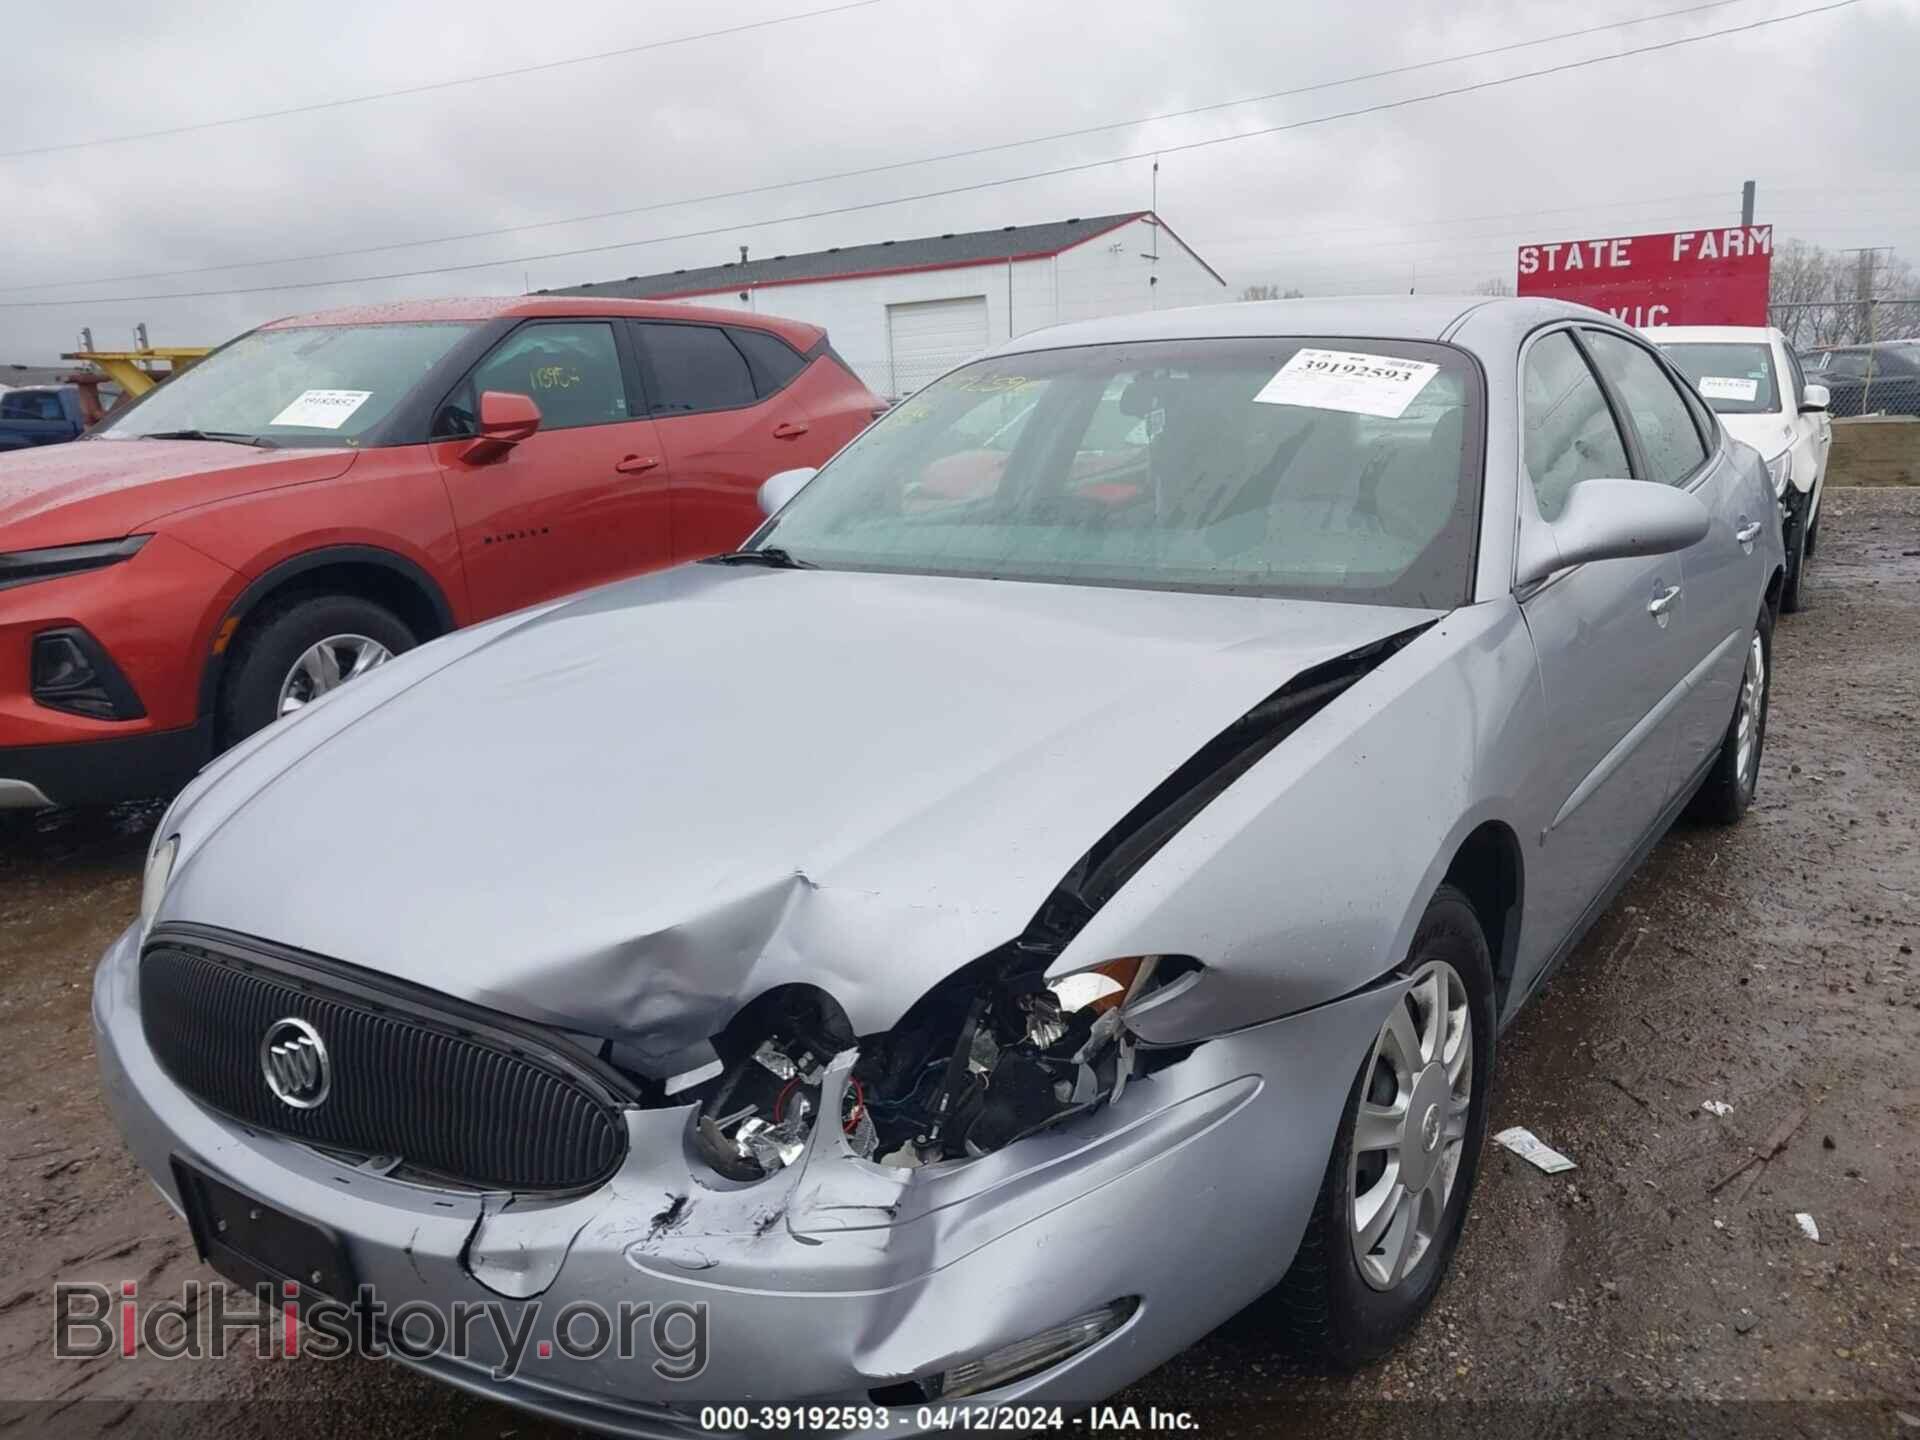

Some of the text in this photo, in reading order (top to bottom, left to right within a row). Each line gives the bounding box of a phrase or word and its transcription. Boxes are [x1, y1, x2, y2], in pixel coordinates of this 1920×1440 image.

[1519, 226, 1771, 274] STATE FARM
[1298, 360, 1413, 382] 39192593
